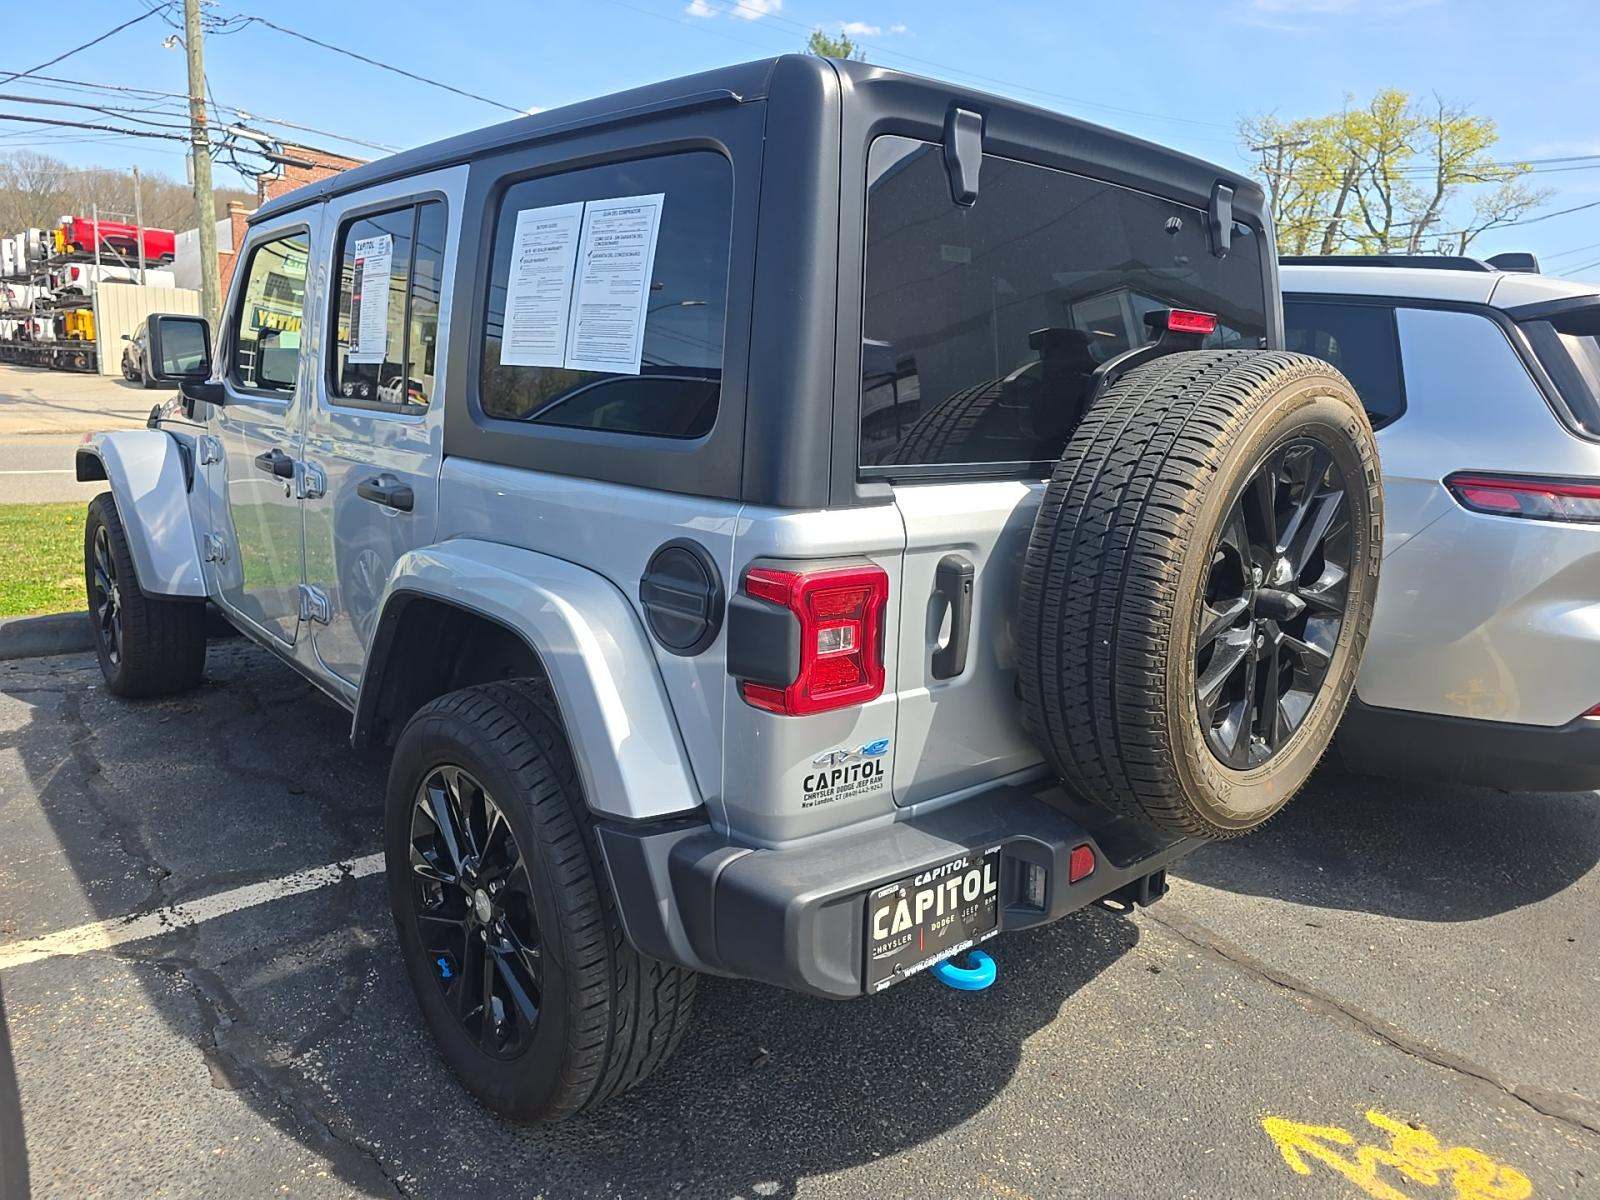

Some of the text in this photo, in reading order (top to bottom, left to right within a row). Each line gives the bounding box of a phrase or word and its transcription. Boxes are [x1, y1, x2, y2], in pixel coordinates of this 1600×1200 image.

[803, 758, 884, 793] CAPITOL
[804, 775, 883, 801] CHRYSLER DODGE JEEP RAM
[802, 801, 813, 809] New
[914, 857, 969, 887] CAPITOL
[873, 863, 997, 940] CAPITOL
[962, 904, 979, 918] JEEP
[985, 895, 997, 906] RAM
[931, 915, 955, 931] DODGE
[872, 933, 912, 955] CHRYSLER
